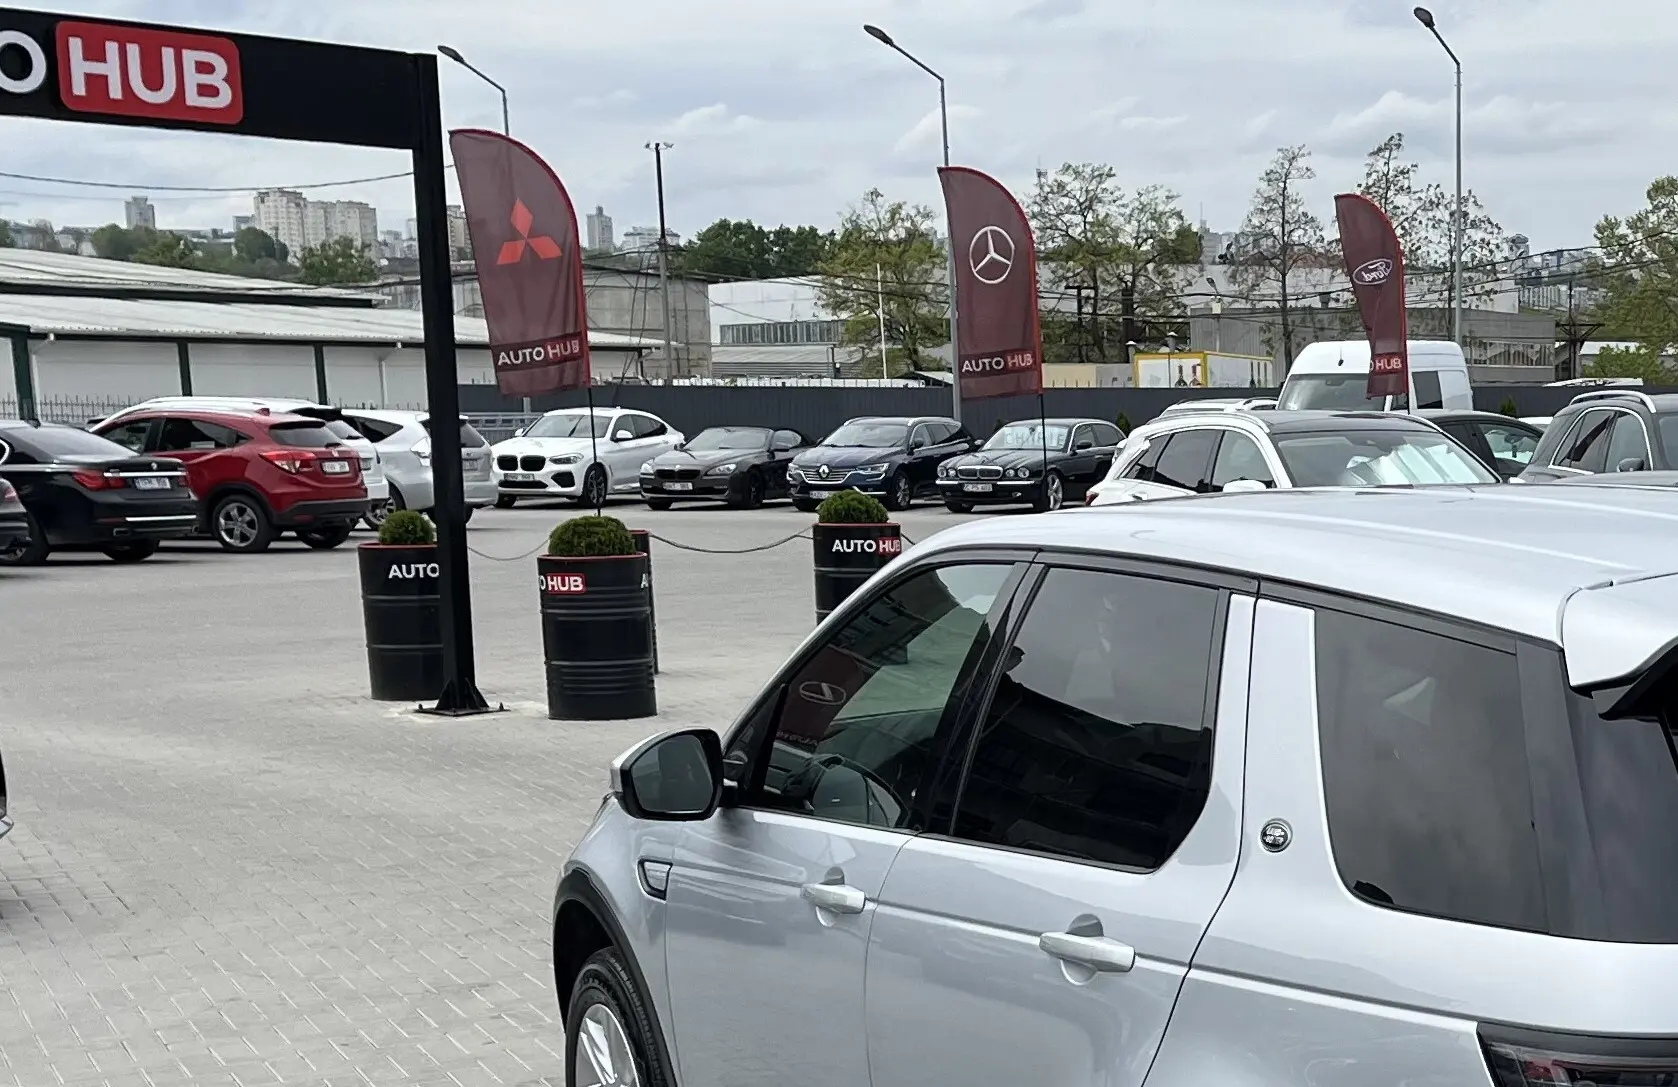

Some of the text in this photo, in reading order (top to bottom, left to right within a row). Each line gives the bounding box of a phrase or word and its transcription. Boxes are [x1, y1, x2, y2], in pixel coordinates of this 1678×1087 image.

[67, 36, 233, 110] HUB
[498, 340, 580, 366] AUTO HUB
[962, 353, 1033, 373] AUTO HUB
[1375, 358, 1402, 370] HUB
[832, 539, 877, 553] AUTO
[388, 563, 440, 579] AUTO
[547, 575, 584, 591] HUB
